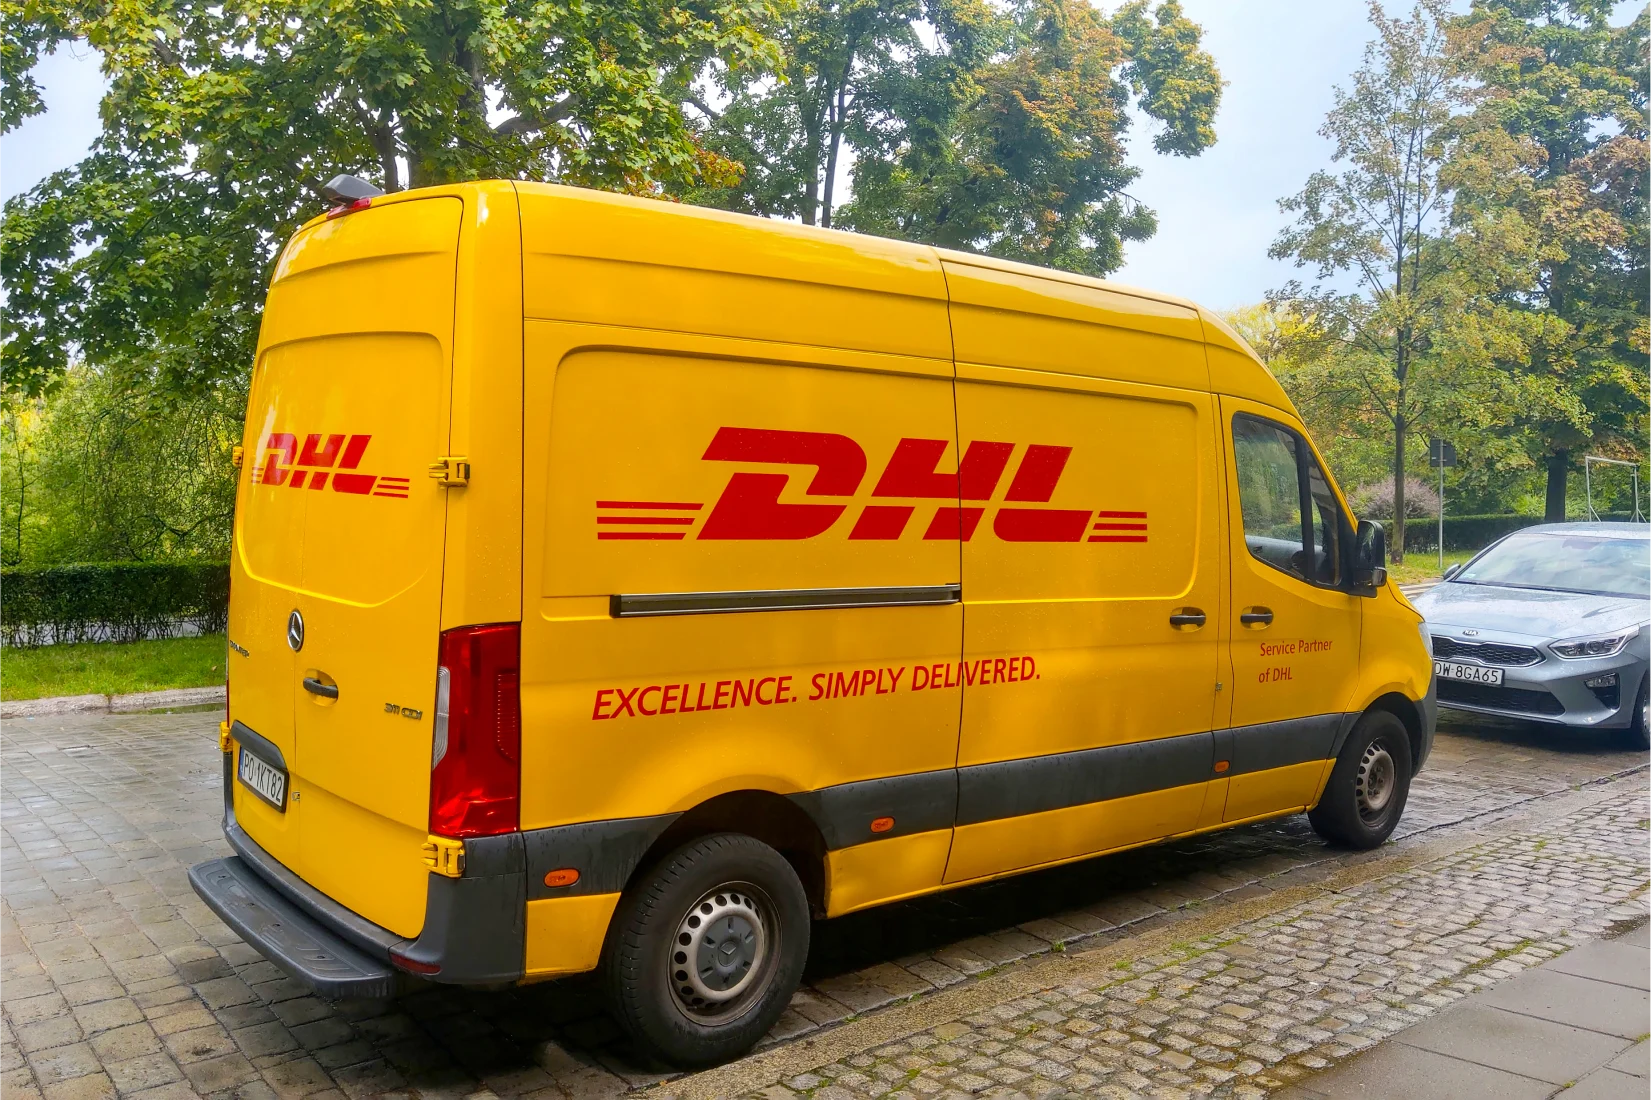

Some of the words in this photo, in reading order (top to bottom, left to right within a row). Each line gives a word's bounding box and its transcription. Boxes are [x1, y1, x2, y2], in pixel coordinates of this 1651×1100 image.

[262, 433, 377, 495] DHL
[696, 427, 1093, 543] DHL
[1260, 641, 1295, 656] Service
[1298, 640, 1333, 653] Partner
[592, 676, 797, 720] EXCELLENCE.
[809, 667, 906, 701] SIMPLY
[911, 656, 1040, 691] DELIVERED.
[1258, 668, 1271, 683] of
[1272, 667, 1293, 682] DHL
[1455, 665, 1499, 683] 8GA65
